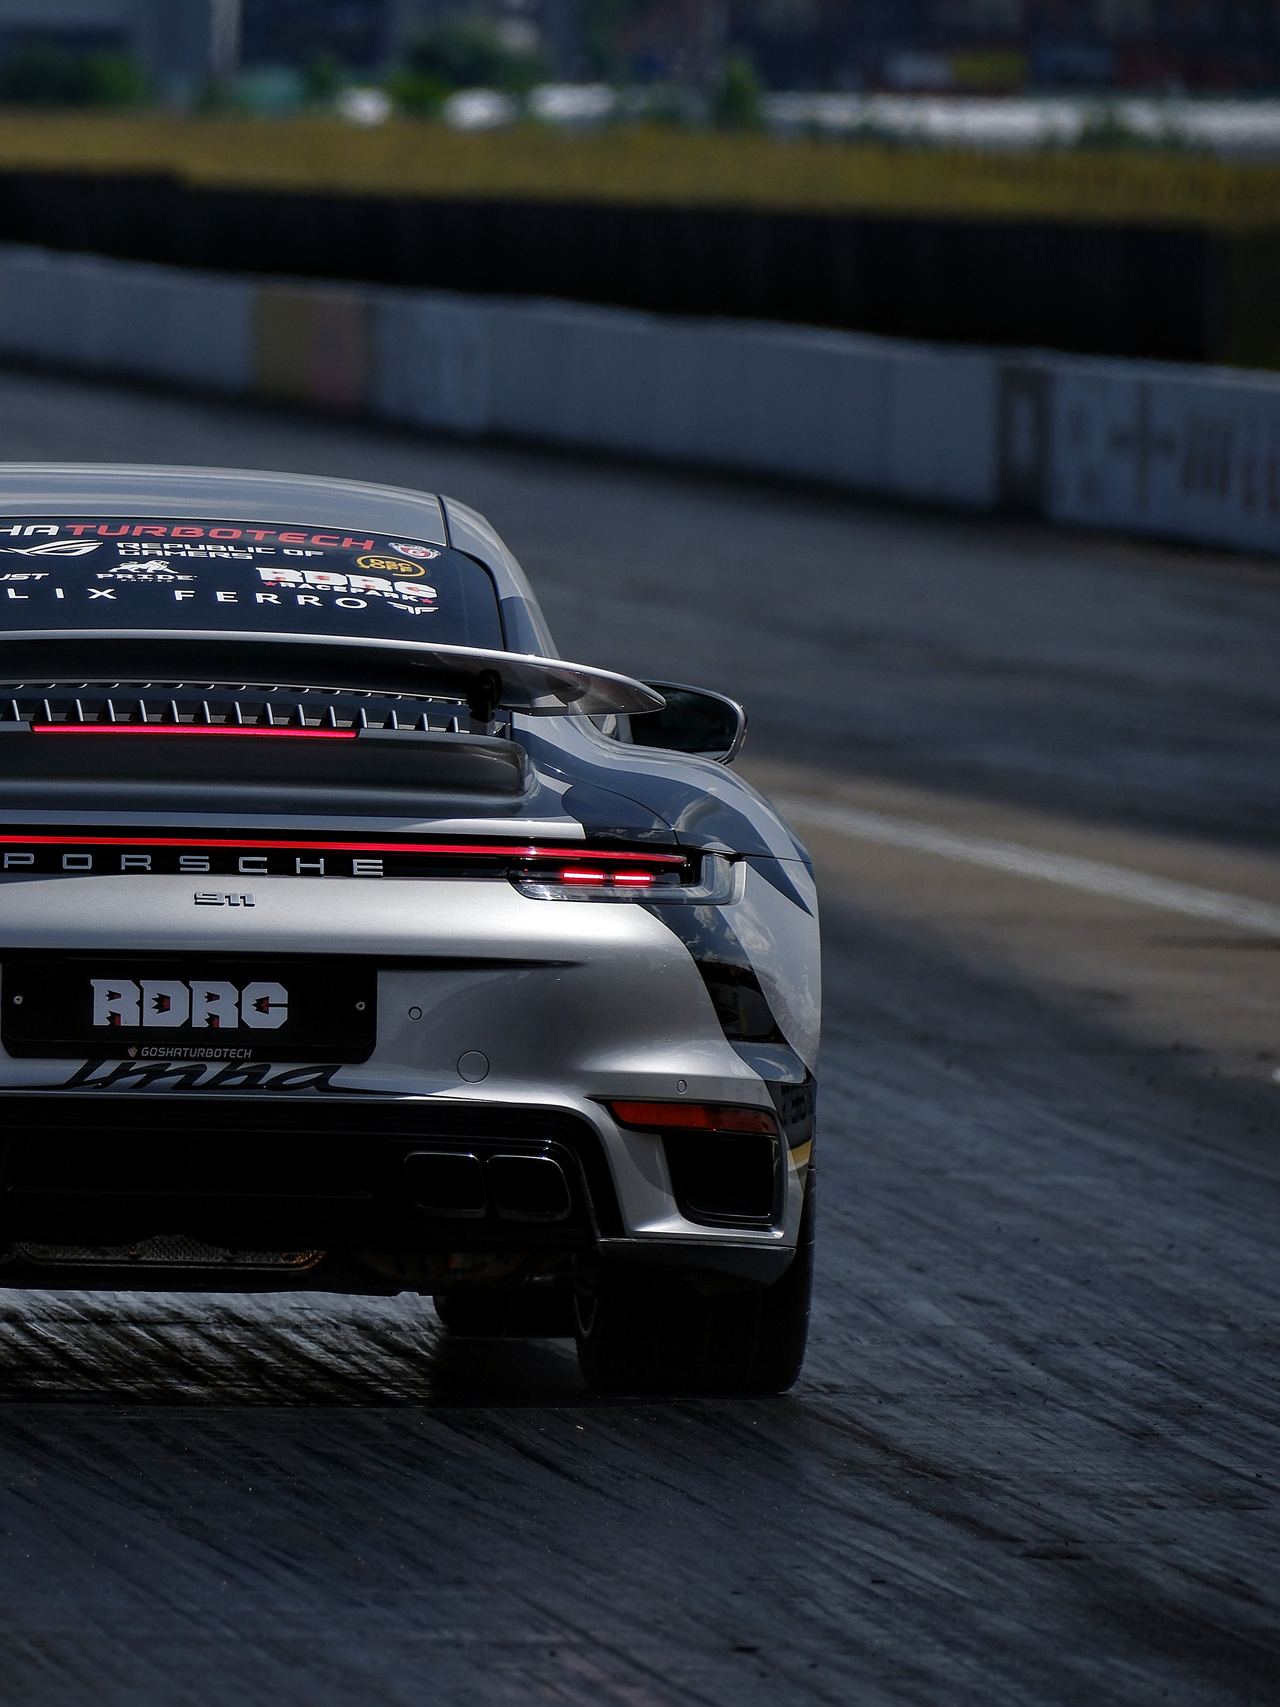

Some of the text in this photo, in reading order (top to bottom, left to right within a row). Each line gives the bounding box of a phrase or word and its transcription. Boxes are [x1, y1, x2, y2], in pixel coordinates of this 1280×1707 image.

[116, 542, 324, 557] REPUBLIC OF
[118, 550, 254, 560] GAMERS
[96, 573, 195, 581] PRIDE
[174, 589, 368, 610] FERRO
[279, 581, 419, 602] RACEPARK
[4, 853, 384, 876] PORSCHE
[194, 891, 257, 908] 911
[90, 979, 289, 1029] RDRC
[140, 1046, 253, 1060] GOSHATURBOTECH
